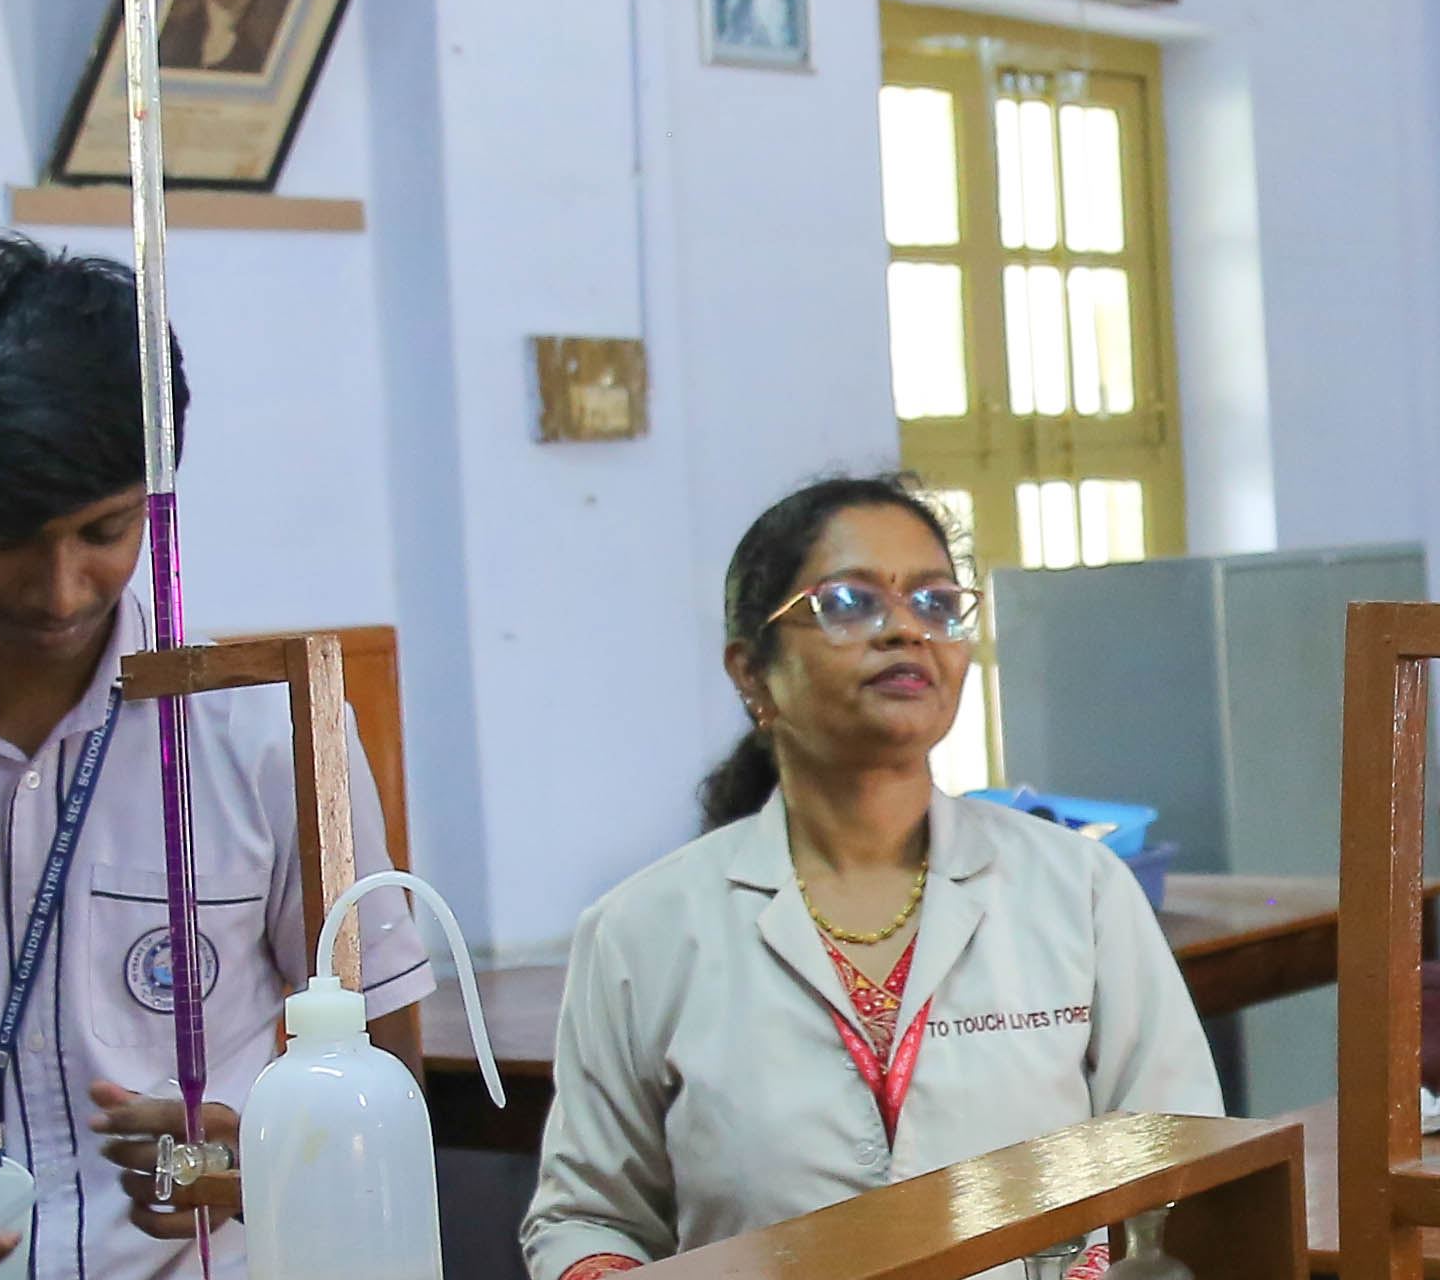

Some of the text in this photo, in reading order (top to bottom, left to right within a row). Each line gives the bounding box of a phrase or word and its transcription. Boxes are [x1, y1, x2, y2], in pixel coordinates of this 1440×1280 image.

[0, 982, 26, 1044] CARMEL
[18, 917, 45, 980] GARDEN
[38, 856, 64, 916] MATRIC
[55, 827, 73, 854] HR.
[66, 791, 86, 823] SEC.
[926, 1020, 949, 1038] TO
[954, 1013, 1006, 1036] TOUCH
[1009, 1011, 1050, 1030] LIVES
